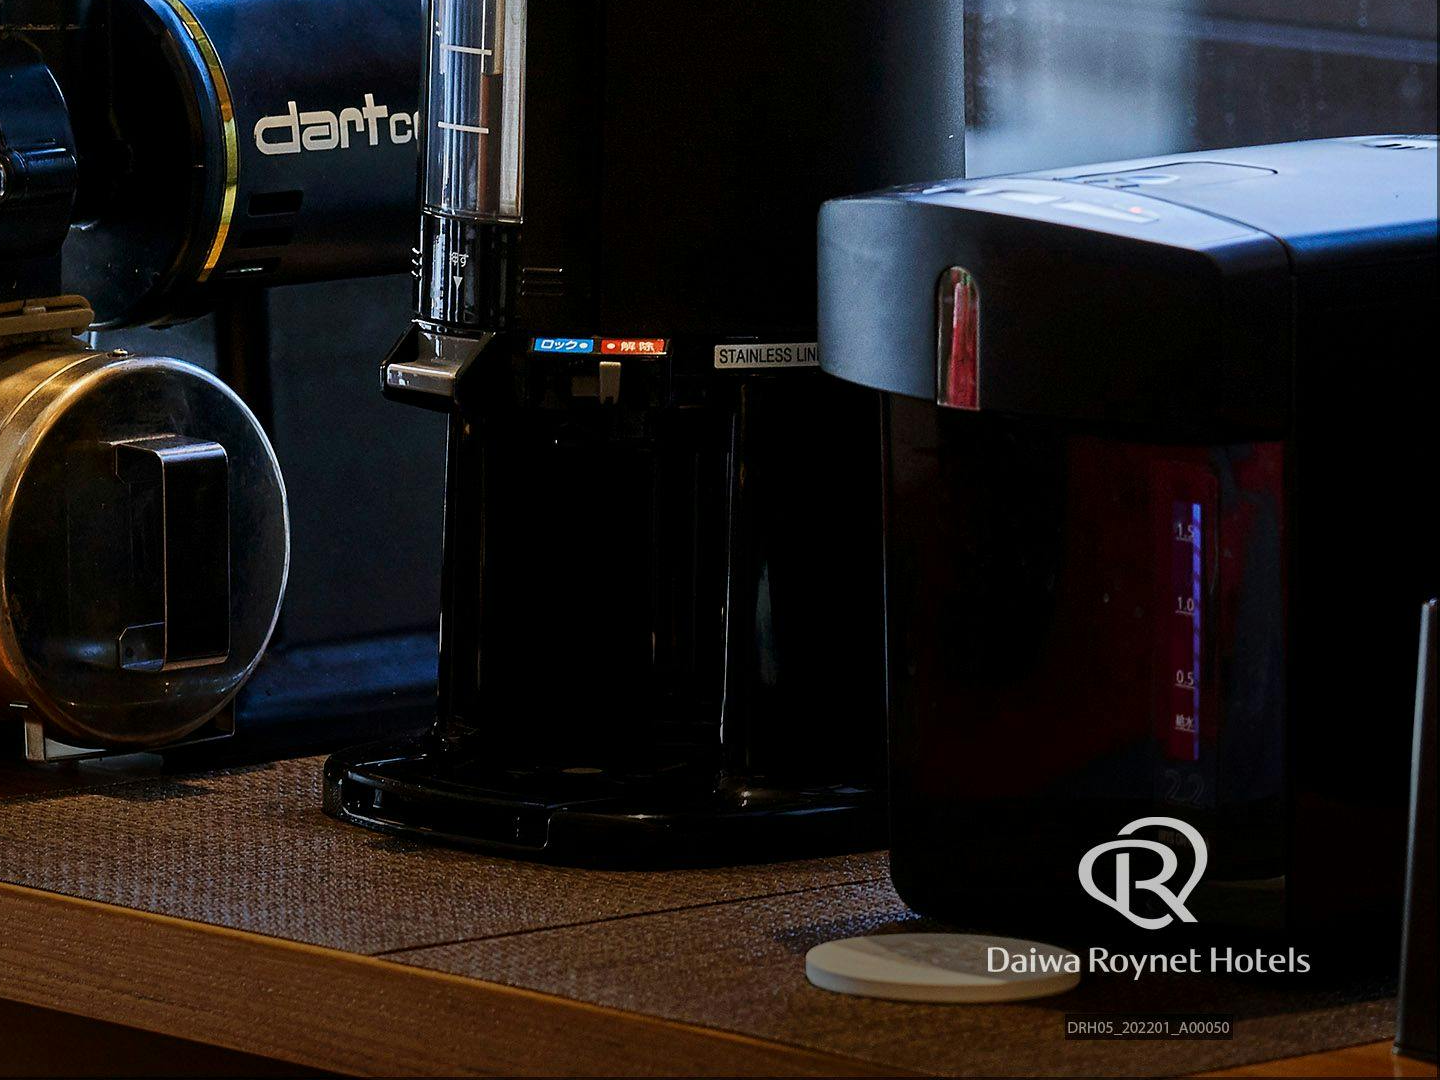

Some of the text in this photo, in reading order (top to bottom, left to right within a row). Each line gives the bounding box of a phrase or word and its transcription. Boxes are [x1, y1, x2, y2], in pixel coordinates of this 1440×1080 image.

[540, 339, 577, 350] ロック
[620, 341, 655, 352] 解除
[719, 346, 820, 364] STAINLESS LIN
[1176, 523, 1195, 538] 1.5
[1177, 596, 1195, 612] 1.0
[1175, 670, 1195, 686] 0.5
